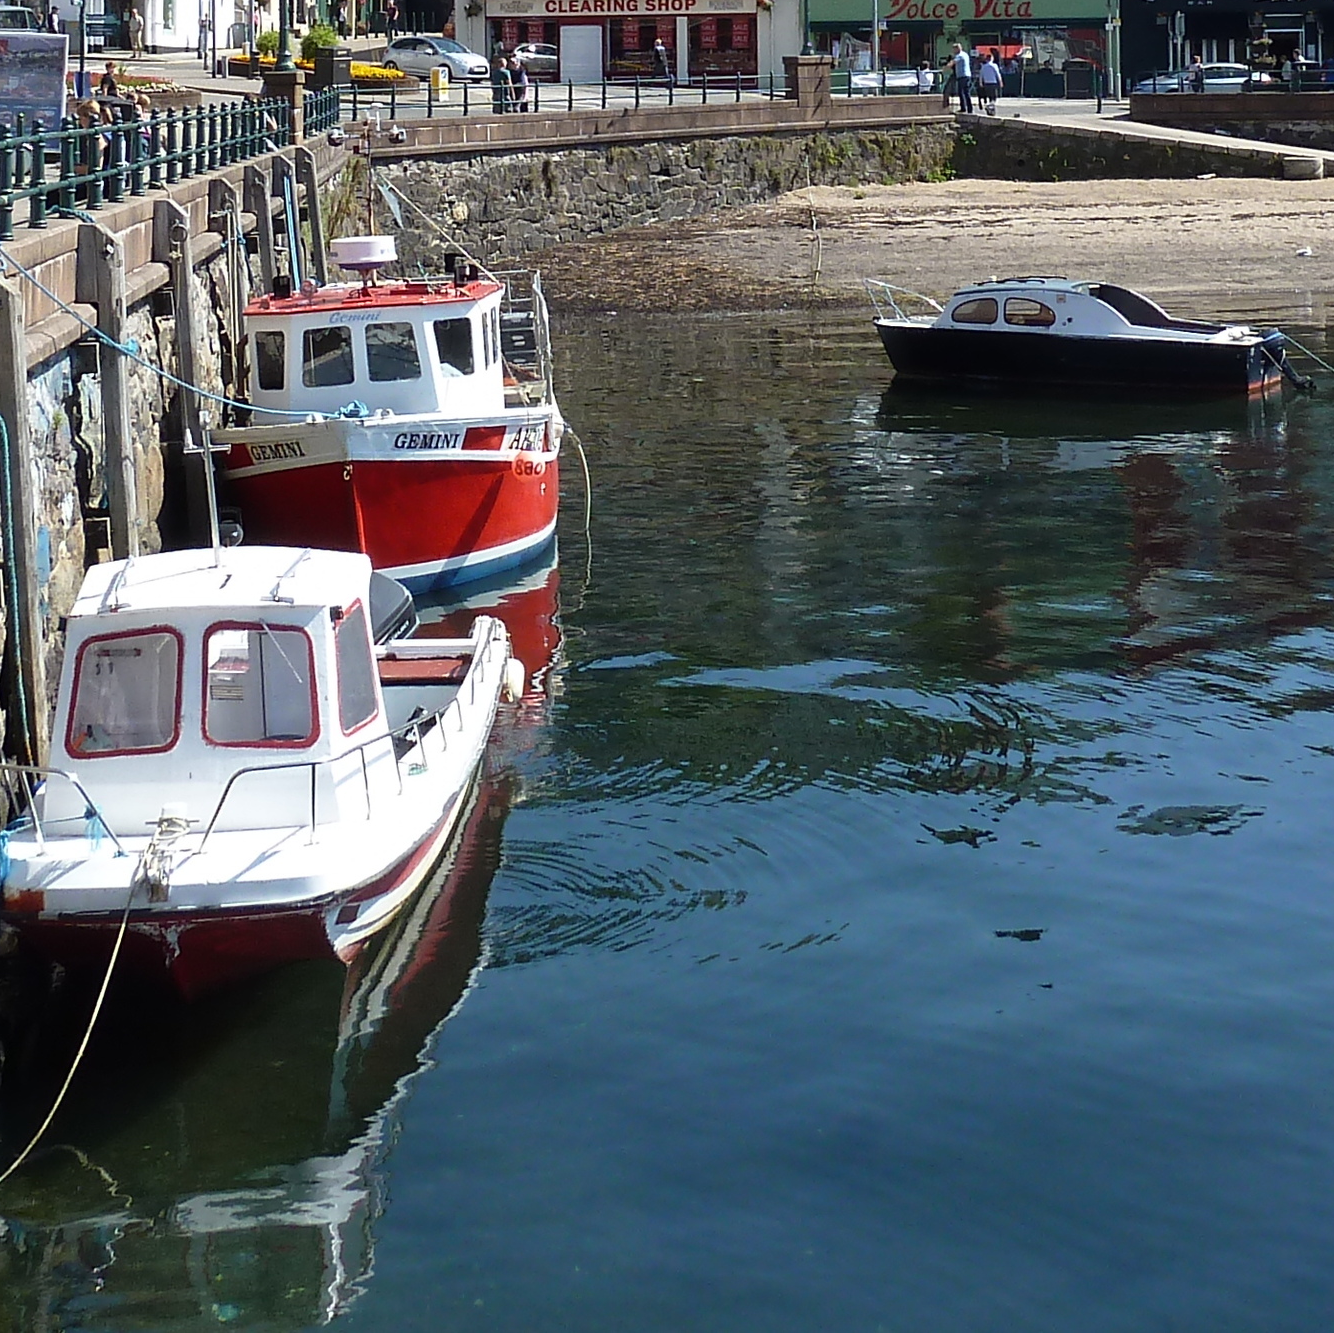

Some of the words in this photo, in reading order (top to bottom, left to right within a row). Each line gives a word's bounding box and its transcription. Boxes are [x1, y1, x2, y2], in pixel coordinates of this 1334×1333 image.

[544, 0, 639, 13] CLEARING
[329, 311, 382, 324] Gemini
[394, 432, 460, 450] GEMINI
[250, 441, 306, 461] GEMINI
